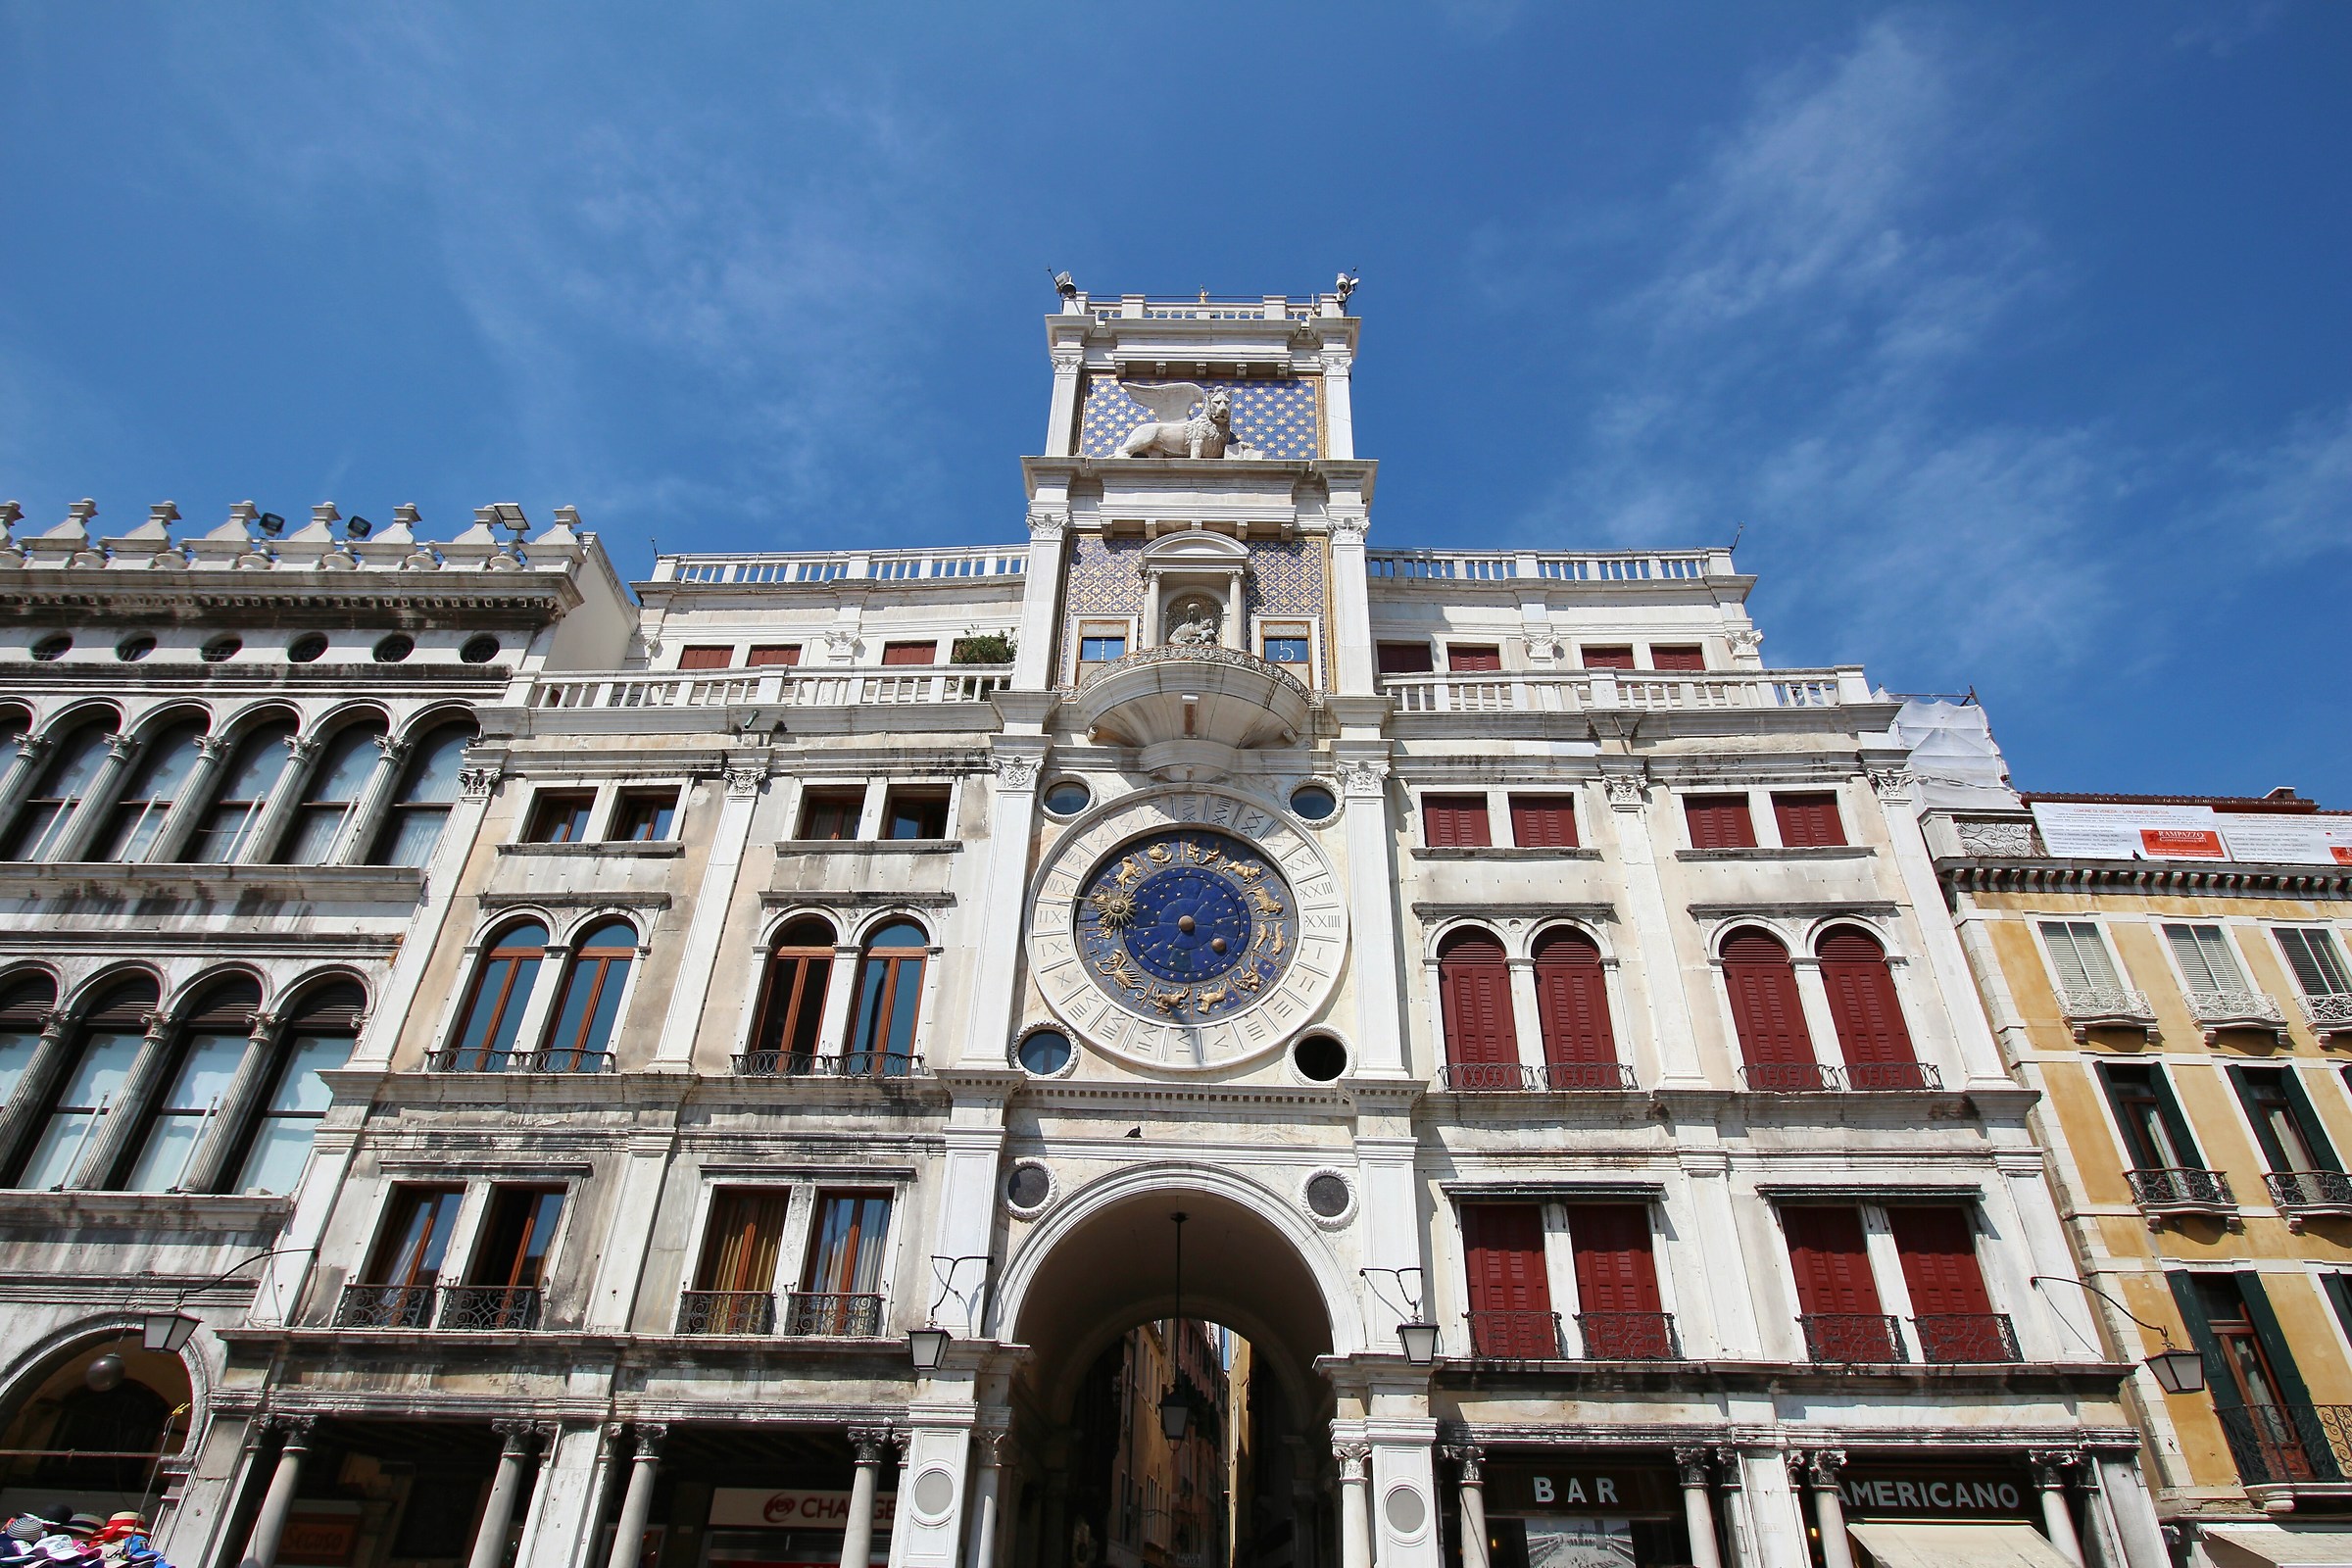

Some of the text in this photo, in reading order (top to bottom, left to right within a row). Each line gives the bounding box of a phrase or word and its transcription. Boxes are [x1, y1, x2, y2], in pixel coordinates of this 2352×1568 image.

[1278, 639, 1295, 662] 5
[1241, 810, 1265, 835] XX
[1285, 851, 1318, 875] XXII
[1298, 881, 1334, 901] XXIII
[1305, 914, 1342, 928] XXIIII
[1054, 971, 1071, 988] X
[1298, 976, 1316, 993] II
[1273, 1000, 1294, 1018] III
[1175, 1032, 1191, 1054] VI
[1213, 1035, 1229, 1048] V
[1533, 1476, 1619, 1503] BAR
[1837, 1481, 2020, 1509] AMERICANO
[801, 1497, 896, 1520] CHAGE
